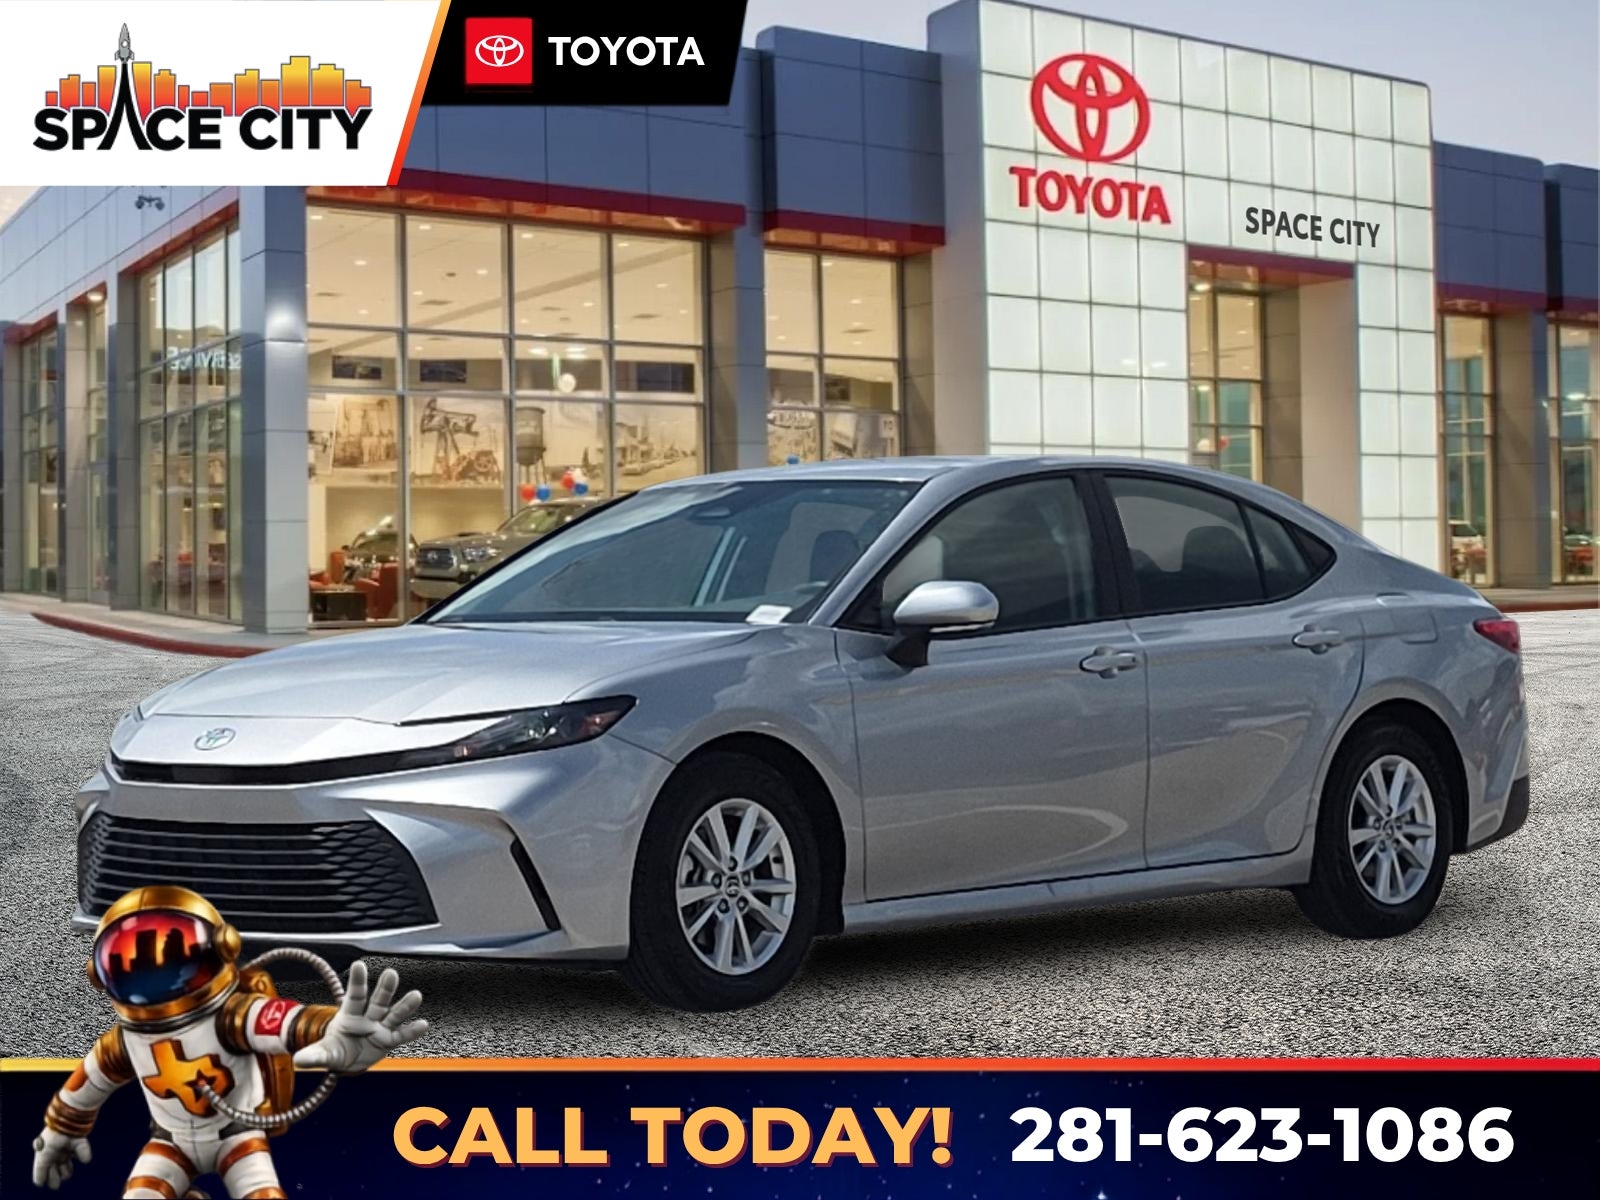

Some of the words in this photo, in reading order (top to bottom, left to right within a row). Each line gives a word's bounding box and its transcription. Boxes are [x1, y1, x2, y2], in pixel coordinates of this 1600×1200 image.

[1009, 166, 1171, 224] TOYOTA
[1245, 206, 1323, 242] SPACE
[1329, 217, 1381, 248] CITY
